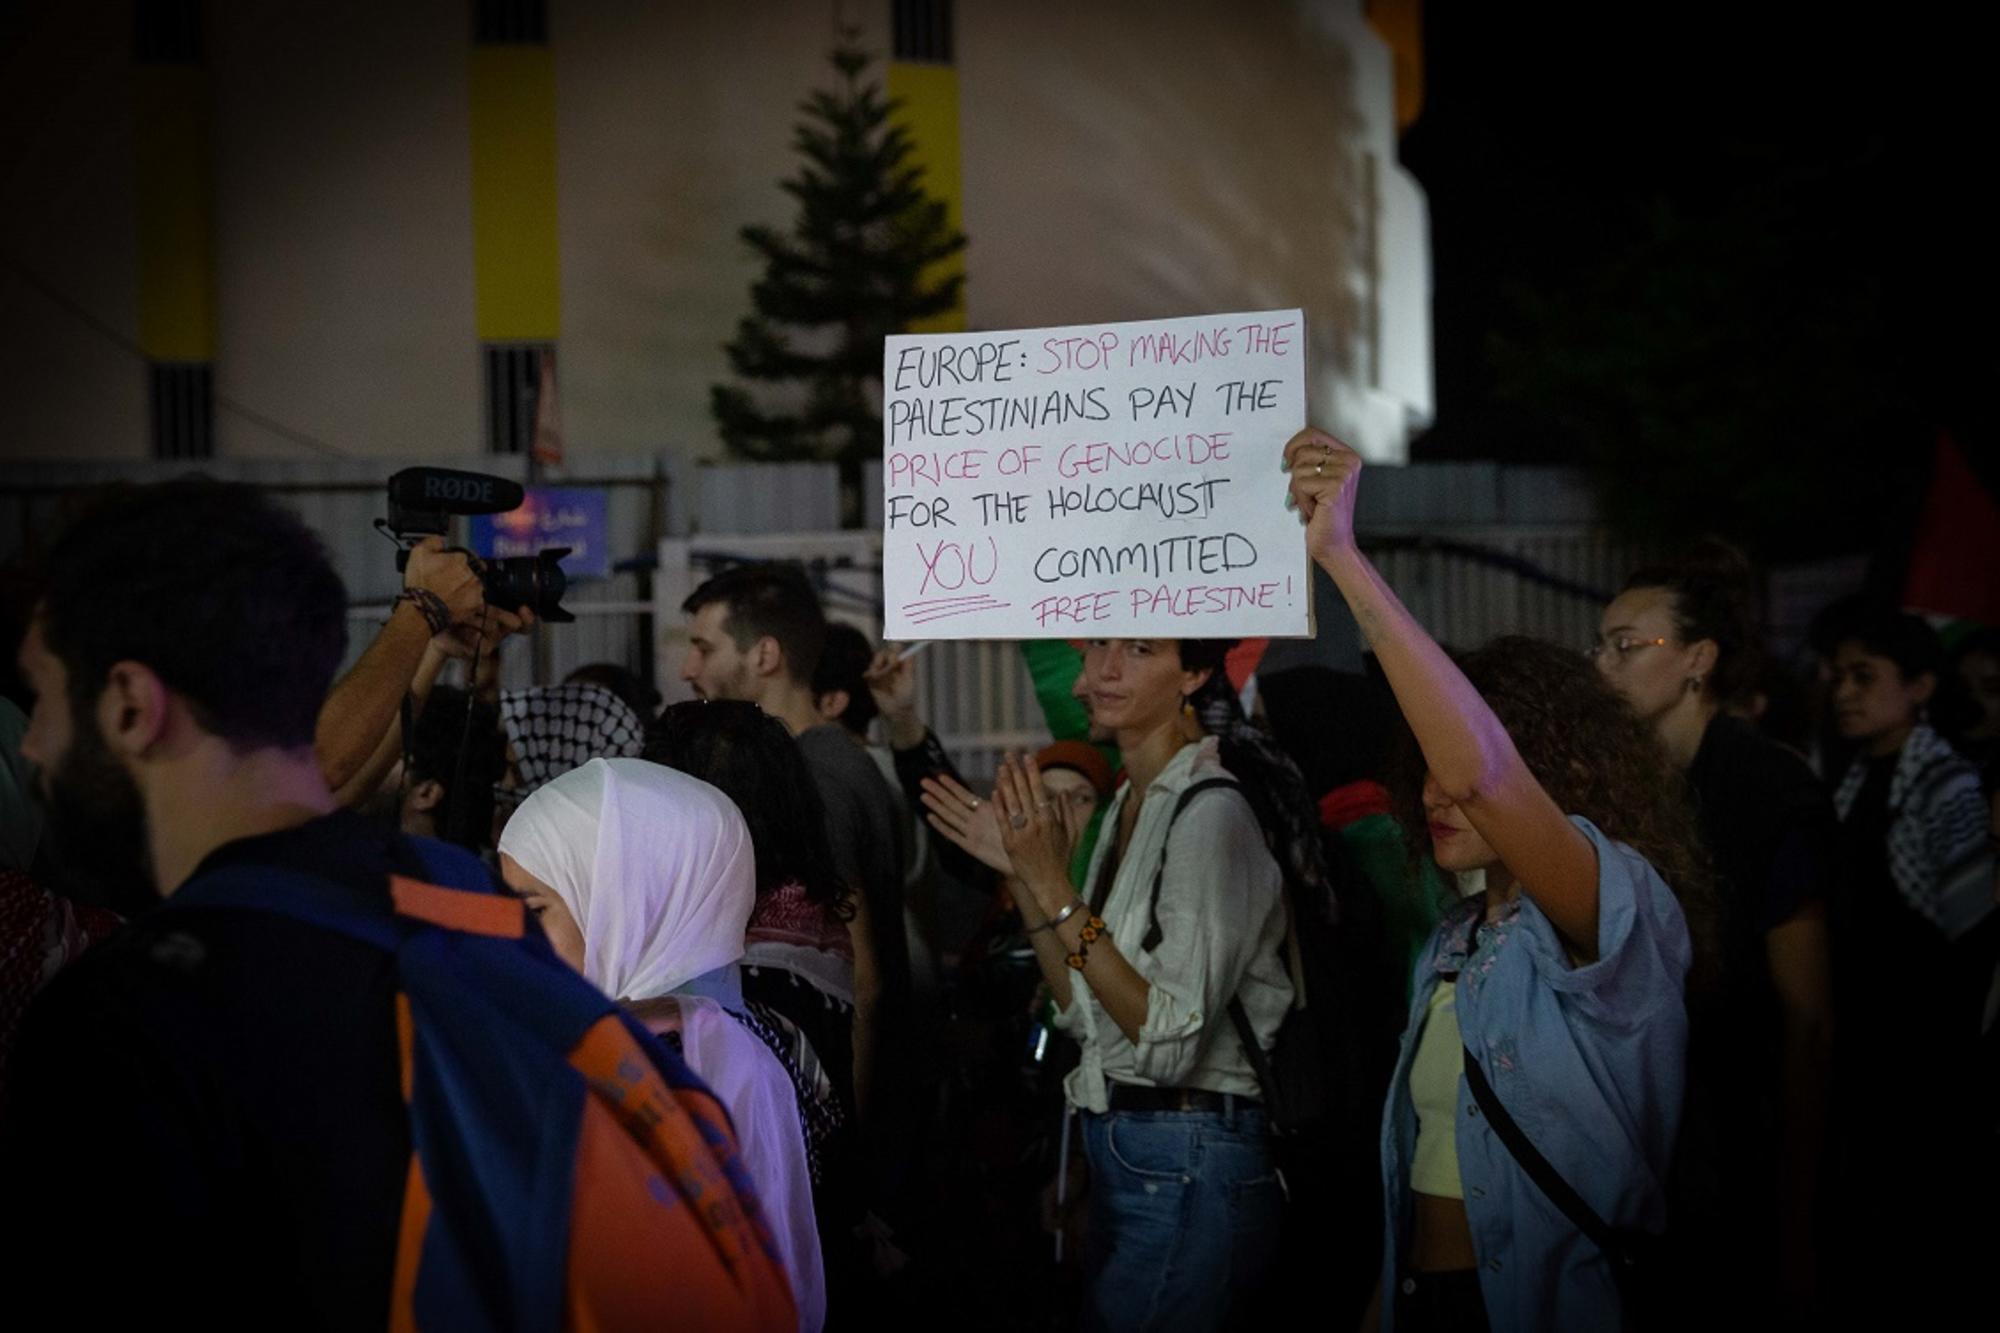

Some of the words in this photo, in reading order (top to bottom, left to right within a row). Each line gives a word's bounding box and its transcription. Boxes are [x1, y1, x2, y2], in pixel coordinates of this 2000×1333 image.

[894, 339, 1028, 392] EUROPE:
[1036, 332, 1119, 375] STOP
[1129, 327, 1232, 368] MAKING
[1237, 322, 1296, 356] THE
[888, 386, 1111, 446] PALESTINIANS
[1128, 382, 1196, 421] PAY
[1216, 380, 1283, 416] THE
[889, 450, 989, 487] PRICE
[997, 444, 1043, 475] OF
[1058, 432, 1235, 479] GENOCIDE
[888, 493, 958, 529] FOR
[973, 493, 1030, 524] THE
[1048, 478, 1231, 520] HOLOCAUST
[916, 535, 999, 595] YOU
[1033, 532, 1258, 584] COMMITTED
[1031, 589, 1120, 628] FREE
